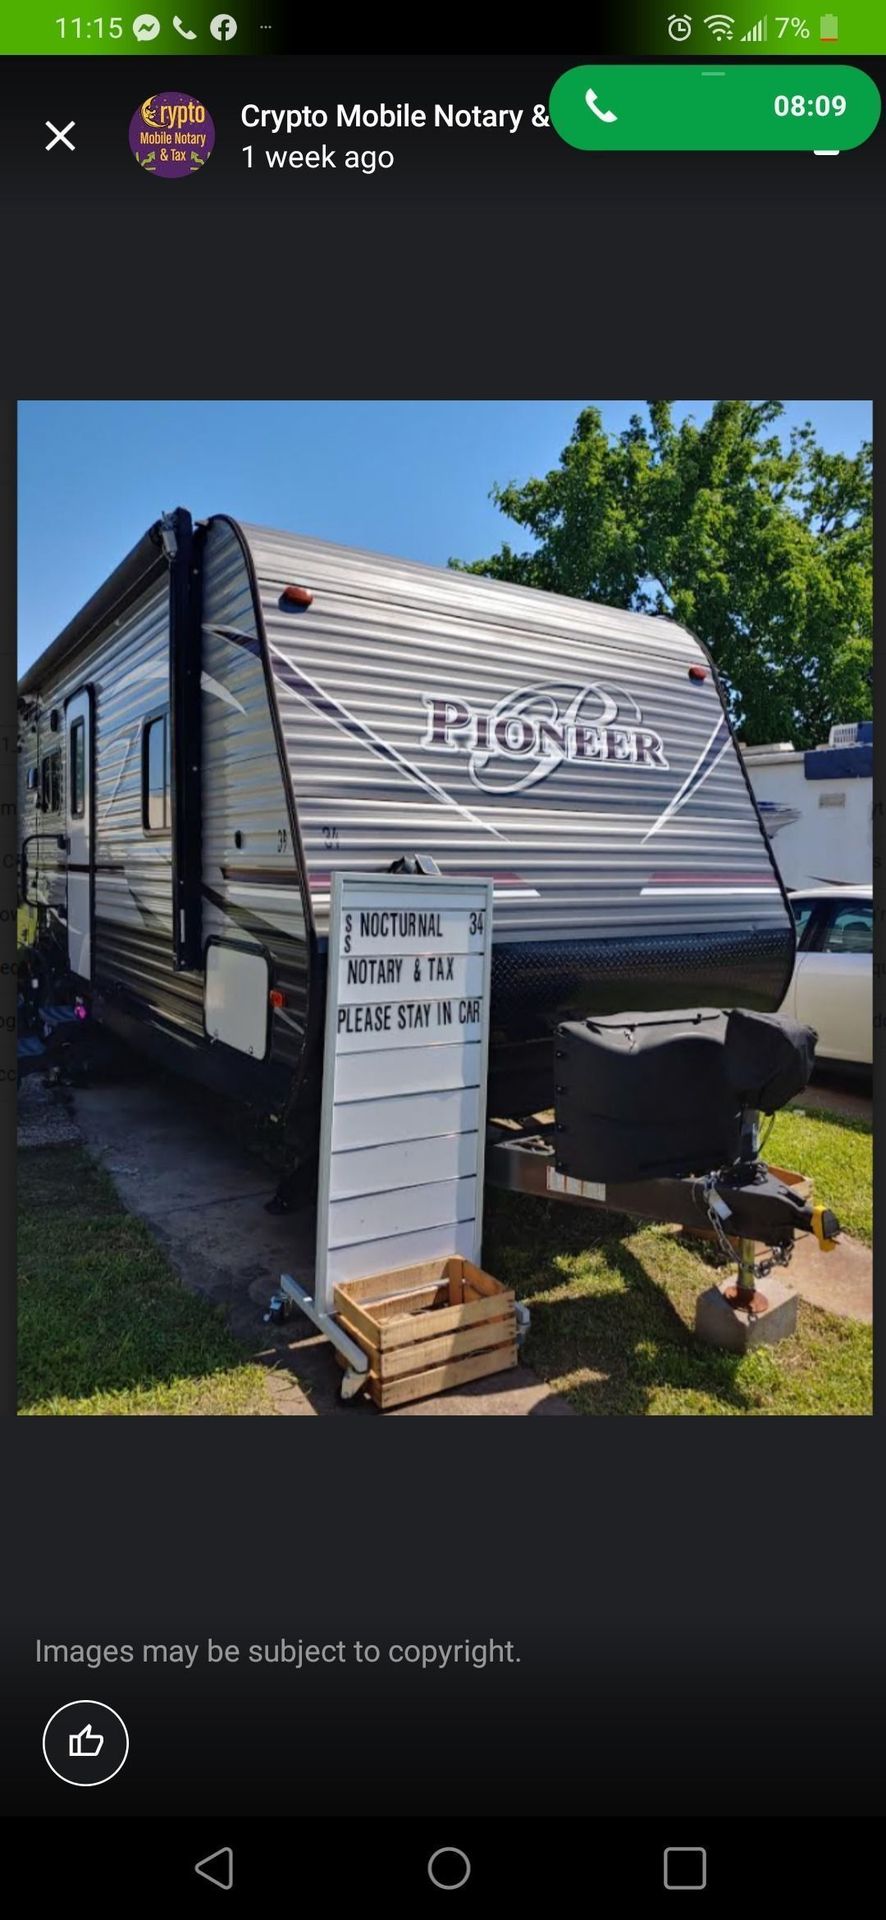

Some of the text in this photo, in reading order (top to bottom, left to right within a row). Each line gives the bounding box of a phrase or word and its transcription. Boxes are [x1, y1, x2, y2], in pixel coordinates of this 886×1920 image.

[421, 693, 670, 770] PIONEER
[360, 912, 443, 938] NOCTURNAL
[469, 912, 483, 935] 34
[347, 957, 454, 985] NOTARY & TAX
[337, 1000, 480, 1034] PLEASE STAY IN CAR
